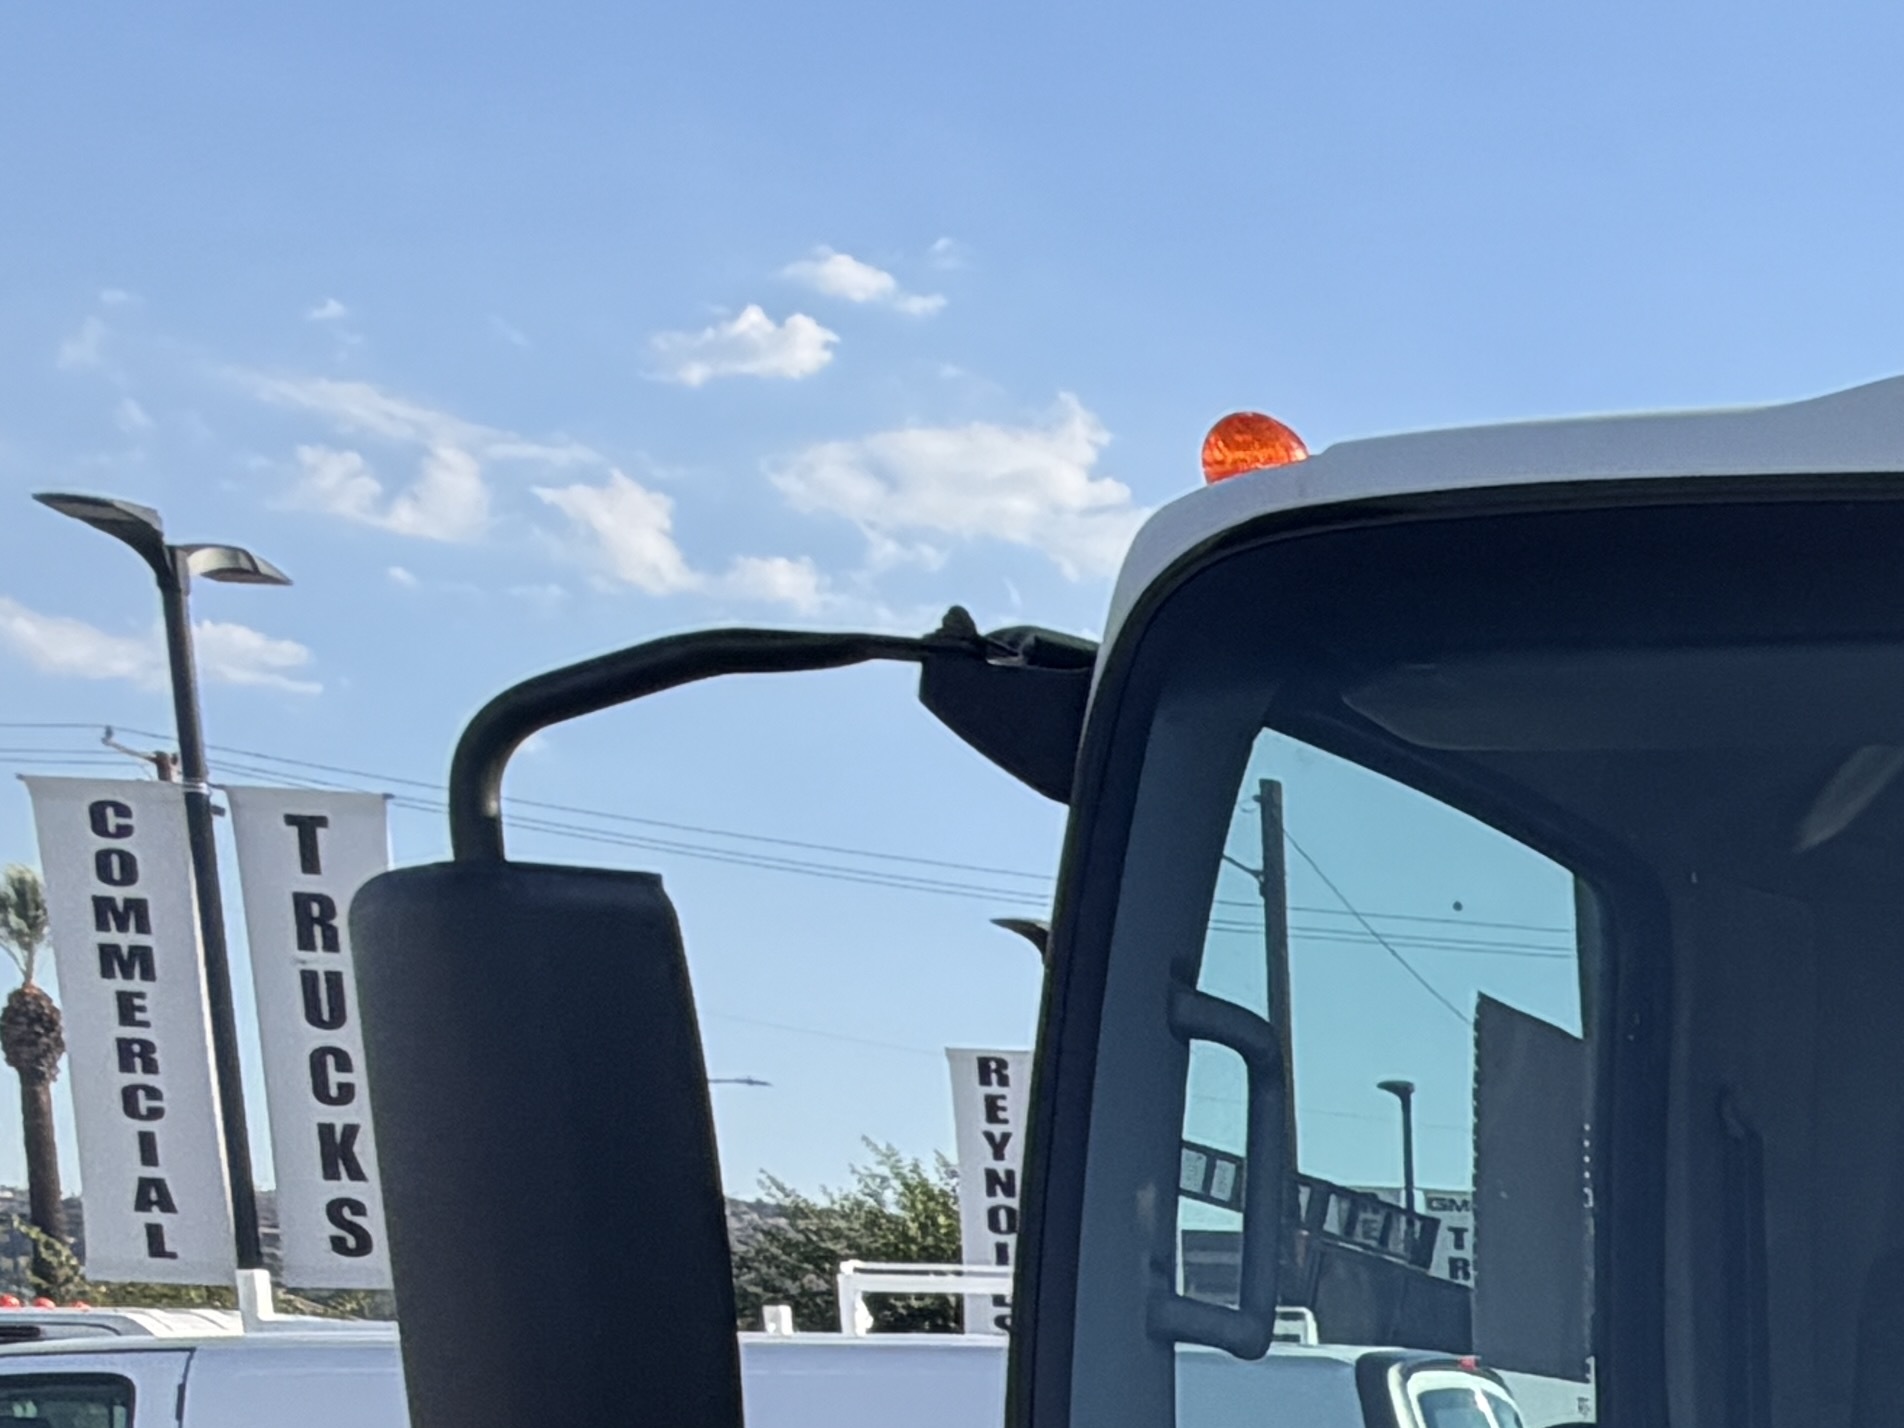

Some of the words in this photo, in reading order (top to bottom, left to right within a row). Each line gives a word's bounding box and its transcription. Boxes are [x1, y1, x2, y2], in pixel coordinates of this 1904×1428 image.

[88, 800, 178, 1259] COMMERCIAL
[283, 814, 374, 1258] TRUCKS
[976, 1056, 1017, 1334] REYNOL
[1427, 1196, 1471, 1213] GM
